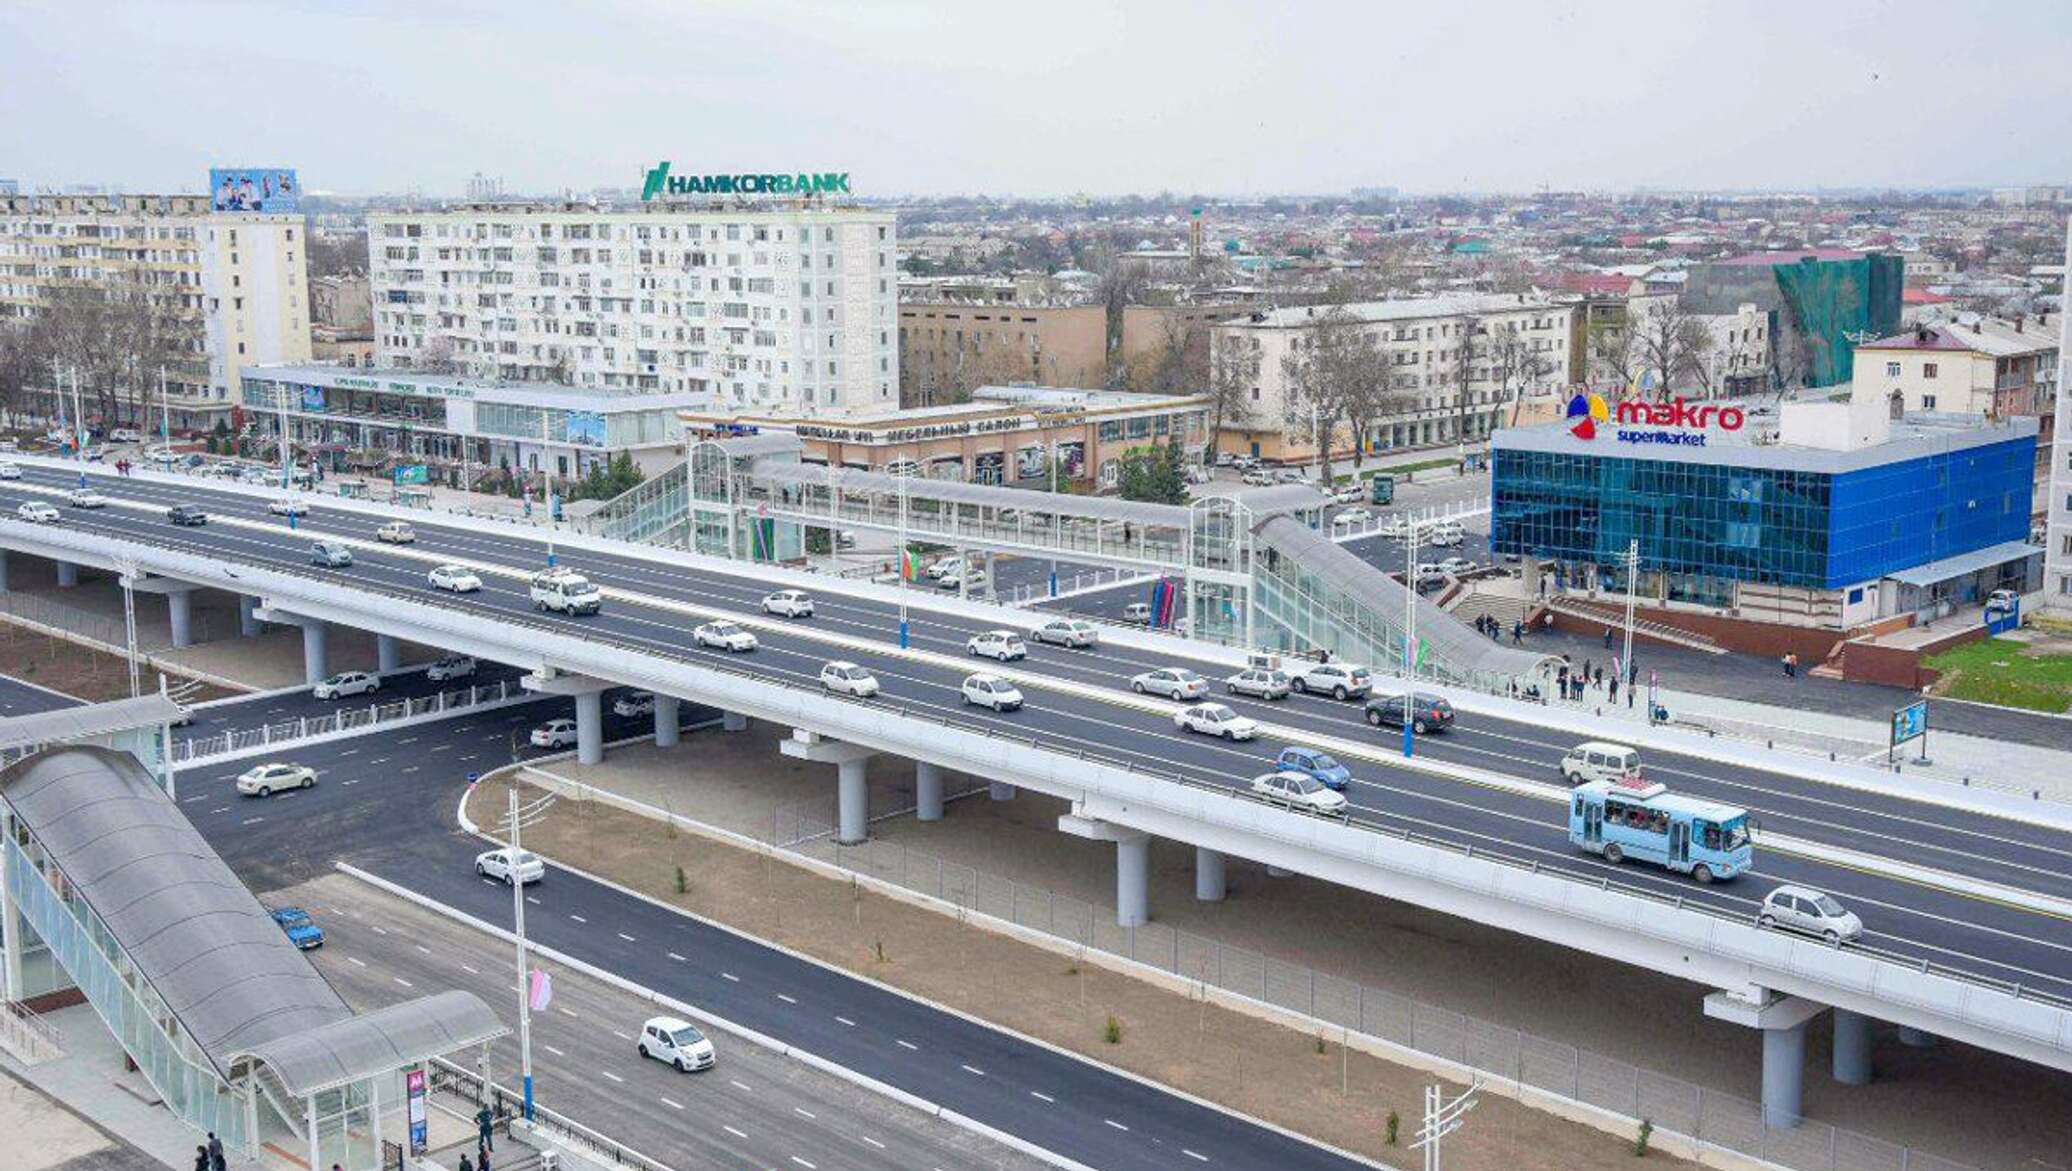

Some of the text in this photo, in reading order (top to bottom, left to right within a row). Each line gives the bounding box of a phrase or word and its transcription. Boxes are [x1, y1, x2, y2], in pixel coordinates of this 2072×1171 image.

[668, 172, 850, 194] HAMKORBANK
[1617, 396, 1744, 430] makro
[1617, 430, 1706, 446] supermarket
